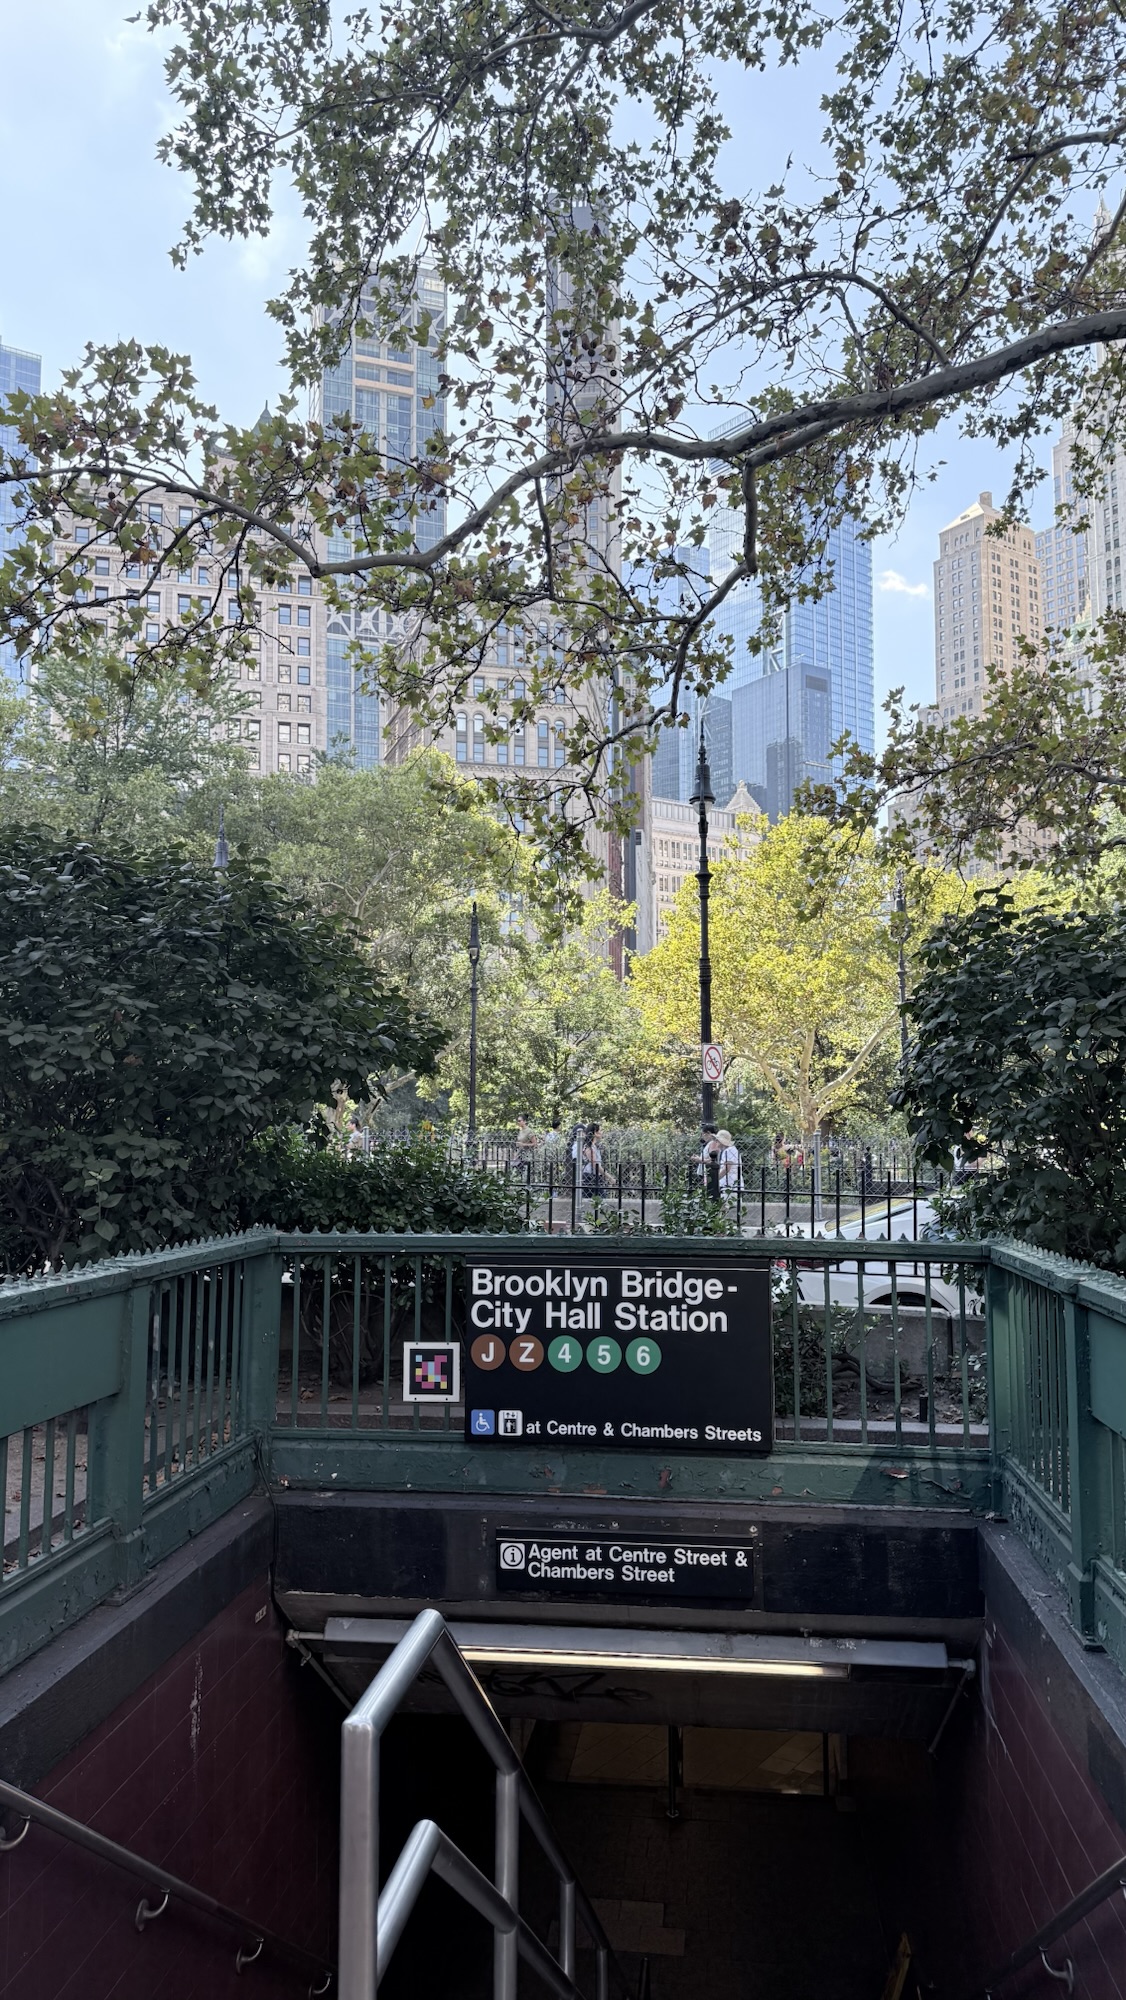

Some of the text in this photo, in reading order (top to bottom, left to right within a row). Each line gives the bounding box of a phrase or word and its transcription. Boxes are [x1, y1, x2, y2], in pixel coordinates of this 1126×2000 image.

[472, 1268, 737, 1305] Brooklyn Bridge-
[471, 1300, 727, 1333] City Hall Station
[480, 1341, 651, 1367] J Z 4 5 6
[526, 1420, 762, 1442] at Centre & Chambers Streets
[528, 1543, 578, 1563] Agent
[585, 1546, 602, 1561] at
[609, 1546, 667, 1564] Centre
[674, 1548, 727, 1566] Street
[735, 1551, 748, 1567] &
[528, 1561, 675, 1582] Chambers Street
